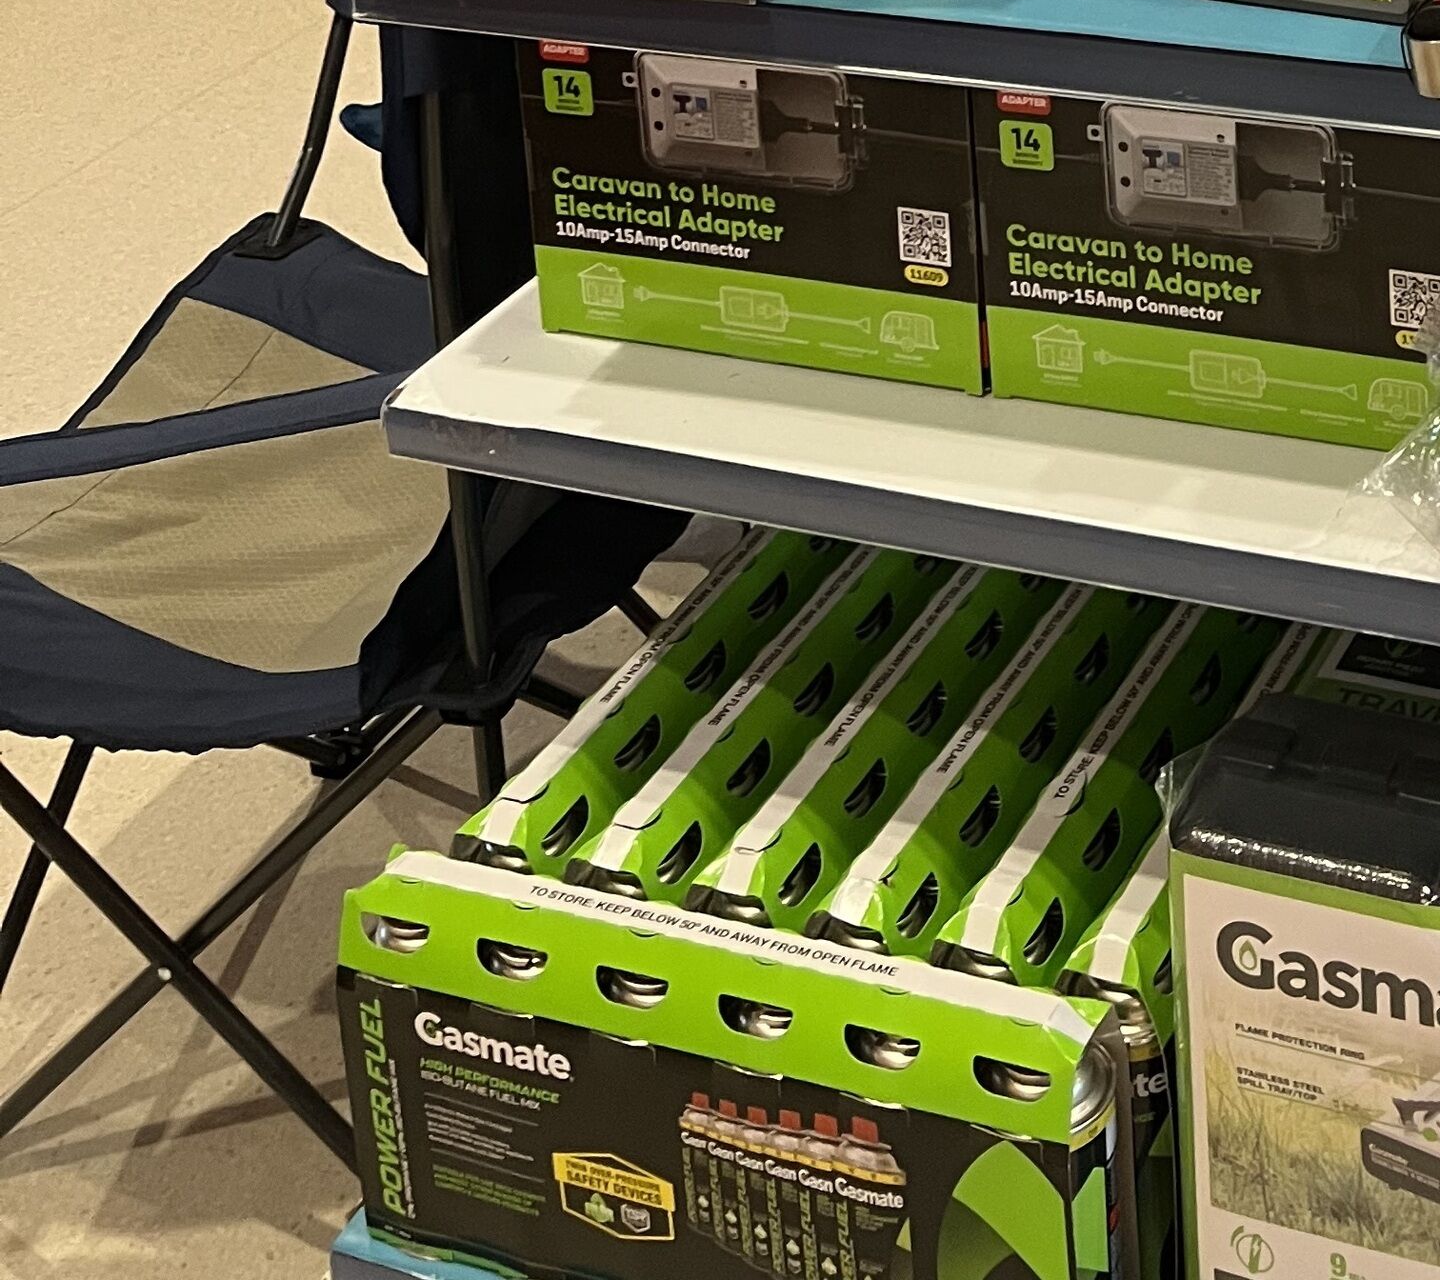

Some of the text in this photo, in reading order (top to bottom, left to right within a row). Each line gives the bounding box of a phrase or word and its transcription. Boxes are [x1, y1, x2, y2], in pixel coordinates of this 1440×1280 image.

[553, 75, 581, 98] 14
[1001, 96, 1047, 108] ADAPTER
[1011, 128, 1040, 152] 14
[552, 167, 777, 214] Caravan to Home
[554, 196, 784, 243] Electrical Adapter
[556, 221, 750, 259] 10Amp-15Amp Connector
[1006, 224, 1254, 275] Caravan to Home
[1008, 252, 1262, 306] Electrical Adapter
[1010, 280, 1224, 323] 10Amp-15Amp Connector
[600, 675, 631, 704] FLAME
[708, 696, 740, 726] FLAME
[824, 714, 856, 747] FLAME
[937, 742, 966, 774] FLAME
[531, 885, 548, 898] TO
[596, 900, 631, 917] KEEP
[631, 908, 680, 927] BELOW
[700, 924, 730, 939] AND
[730, 931, 769, 948] AWAY
[769, 940, 811, 958] FROM
[811, 949, 851, 967] OPEN
[850, 958, 900, 978] FLAME
[414, 1011, 572, 1080] Gasmate
[1235, 1022, 1366, 1060] FLAME PROTECTION RING
[420, 1056, 560, 1104] HIGH PERFORMANCE
[1237, 1066, 1325, 1095] STAINLESS STEEL
[1237, 1076, 1318, 1102] SPILL TRAY/TOP
[360, 997, 408, 1216] POWER FUEL
[566, 1170, 662, 1206] SAFETY DEVICES
[835, 1178, 905, 1209] Gasmate
[1329, 1252, 1347, 1277] 9
